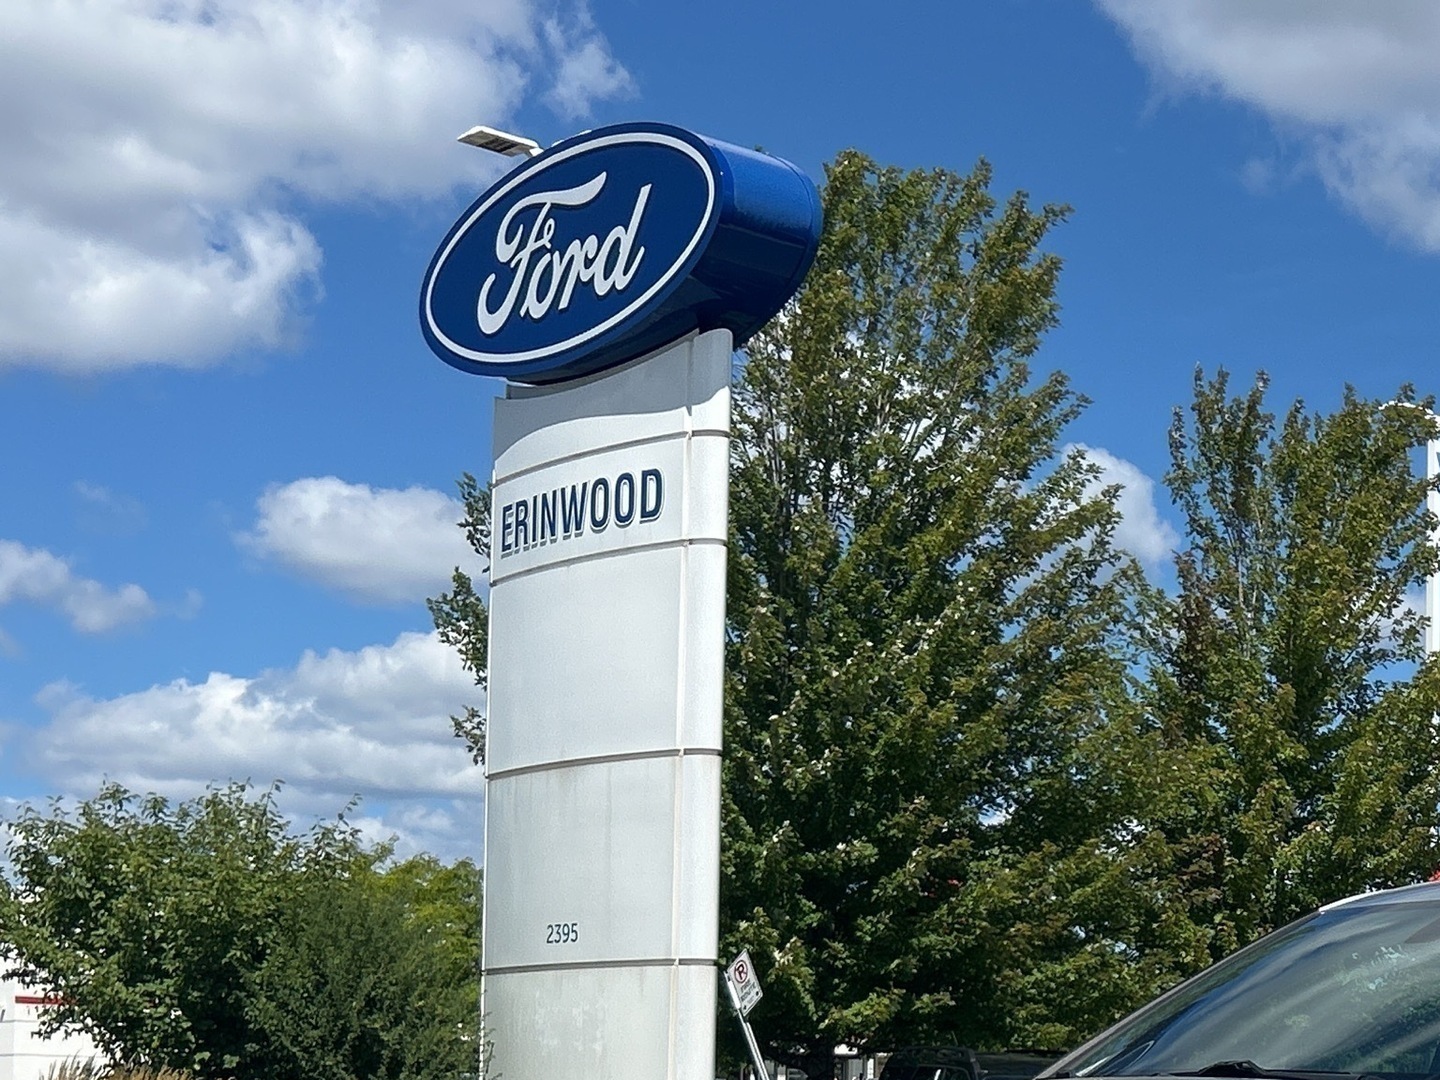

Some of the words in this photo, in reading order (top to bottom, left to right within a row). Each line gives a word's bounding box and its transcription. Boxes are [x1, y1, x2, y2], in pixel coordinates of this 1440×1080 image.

[477, 171, 652, 336] Ford
[501, 468, 666, 559] ERINWOOD
[546, 922, 579, 944] 2395
